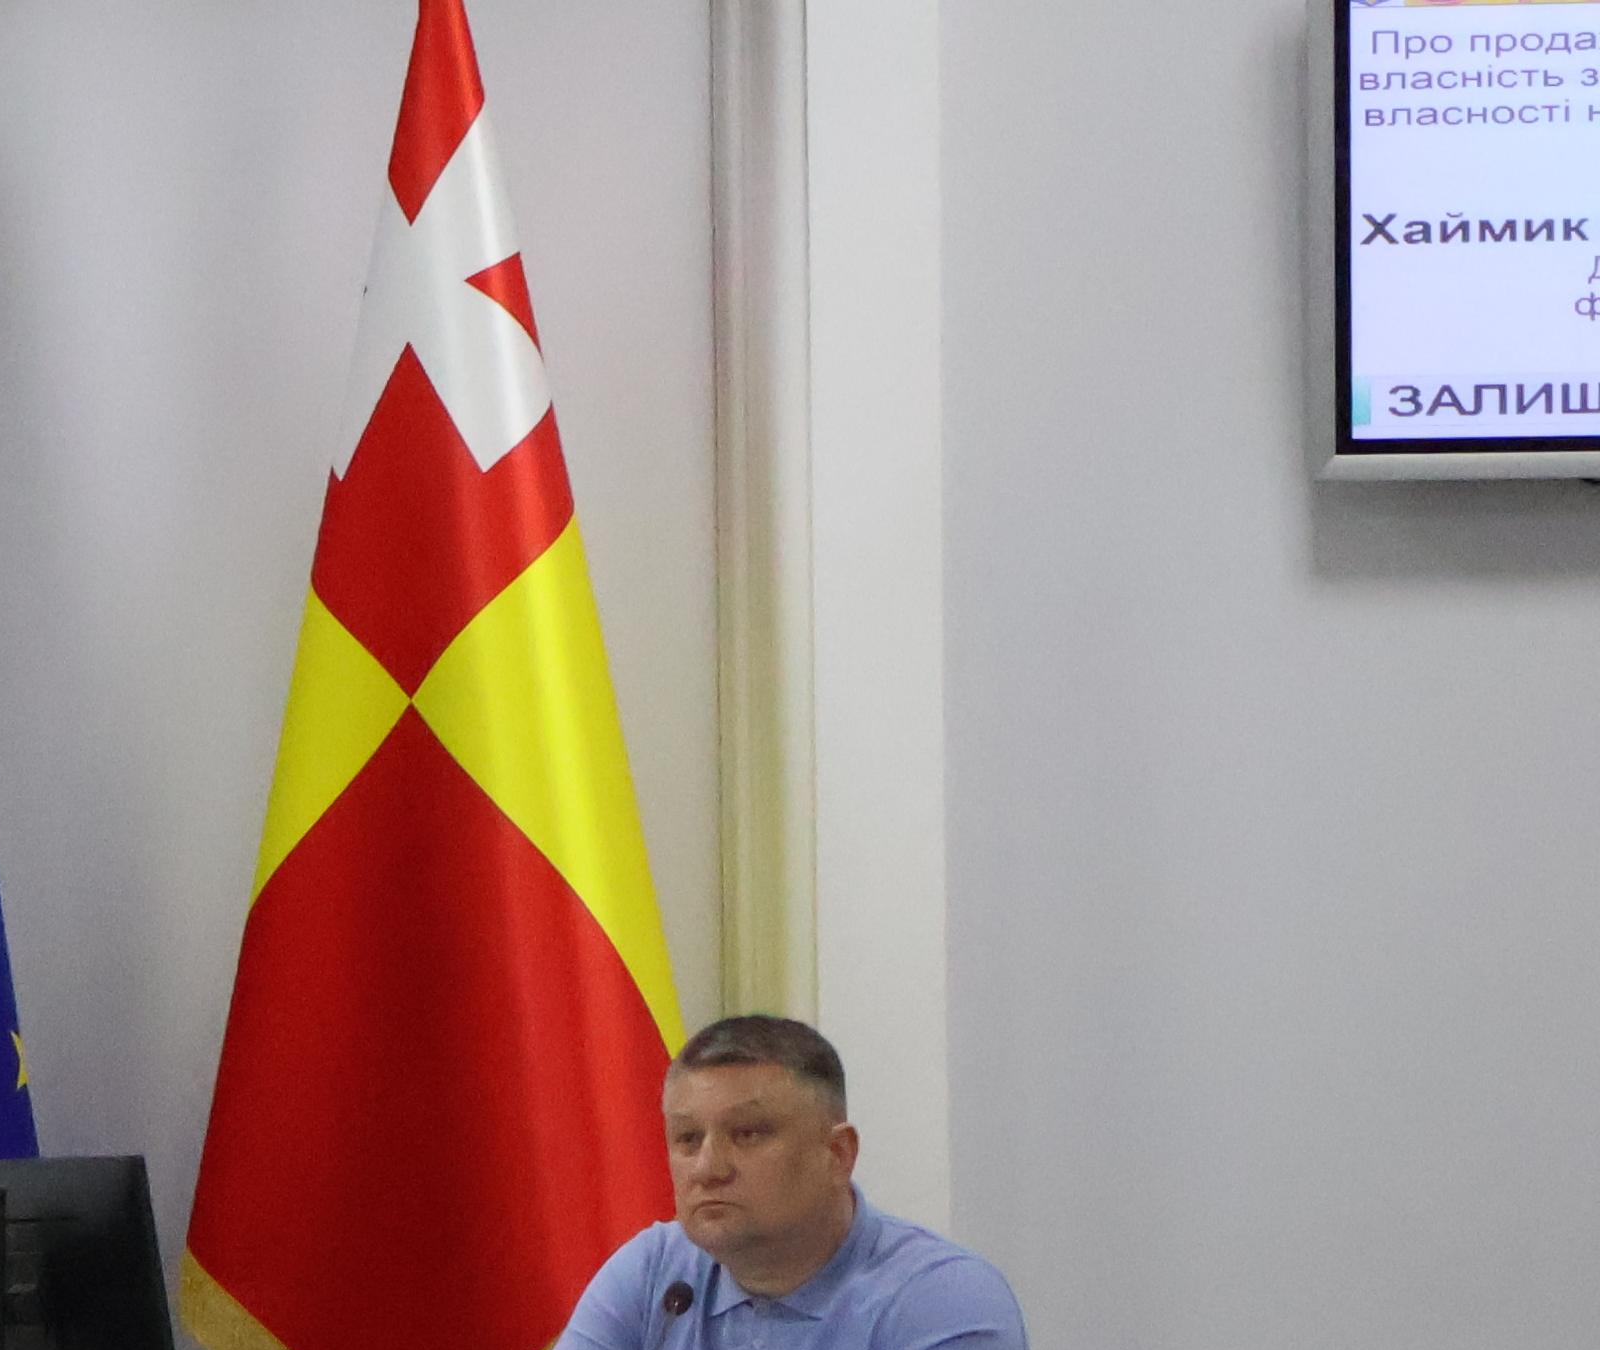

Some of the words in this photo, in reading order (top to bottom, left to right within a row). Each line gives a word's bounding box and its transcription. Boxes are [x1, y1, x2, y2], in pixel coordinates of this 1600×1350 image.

[1371, 30, 1453, 59] Про
[1469, 29, 1600, 58] прода
[1359, 64, 1564, 91] власність
[1364, 99, 1570, 126] власності
[1360, 212, 1589, 246] Хаймик
[1388, 382, 1600, 417] ЗАЛИШ
